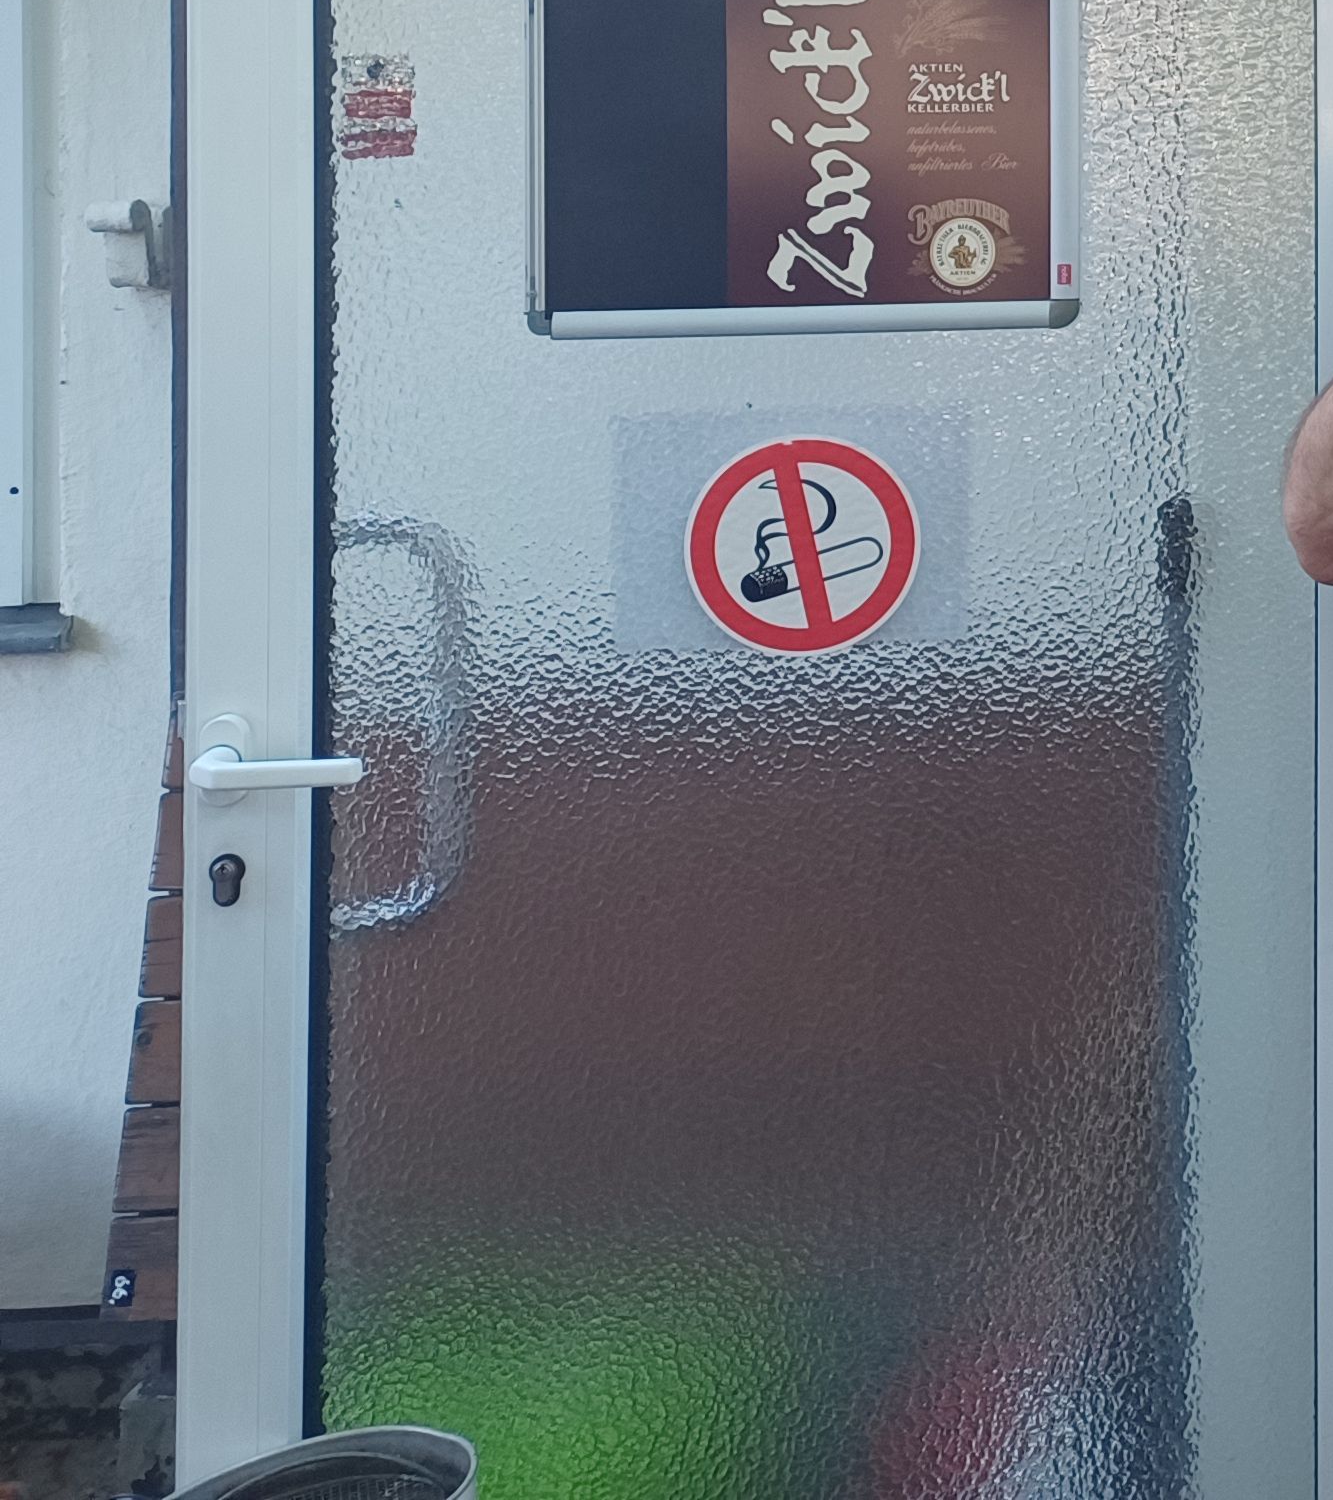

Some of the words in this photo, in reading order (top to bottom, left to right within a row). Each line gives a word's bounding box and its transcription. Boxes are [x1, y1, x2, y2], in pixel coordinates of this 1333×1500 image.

[908, 63, 963, 73] AKTIEN
[907, 71, 1011, 103] Zwick'l
[907, 103, 995, 113] KELLERBIER
